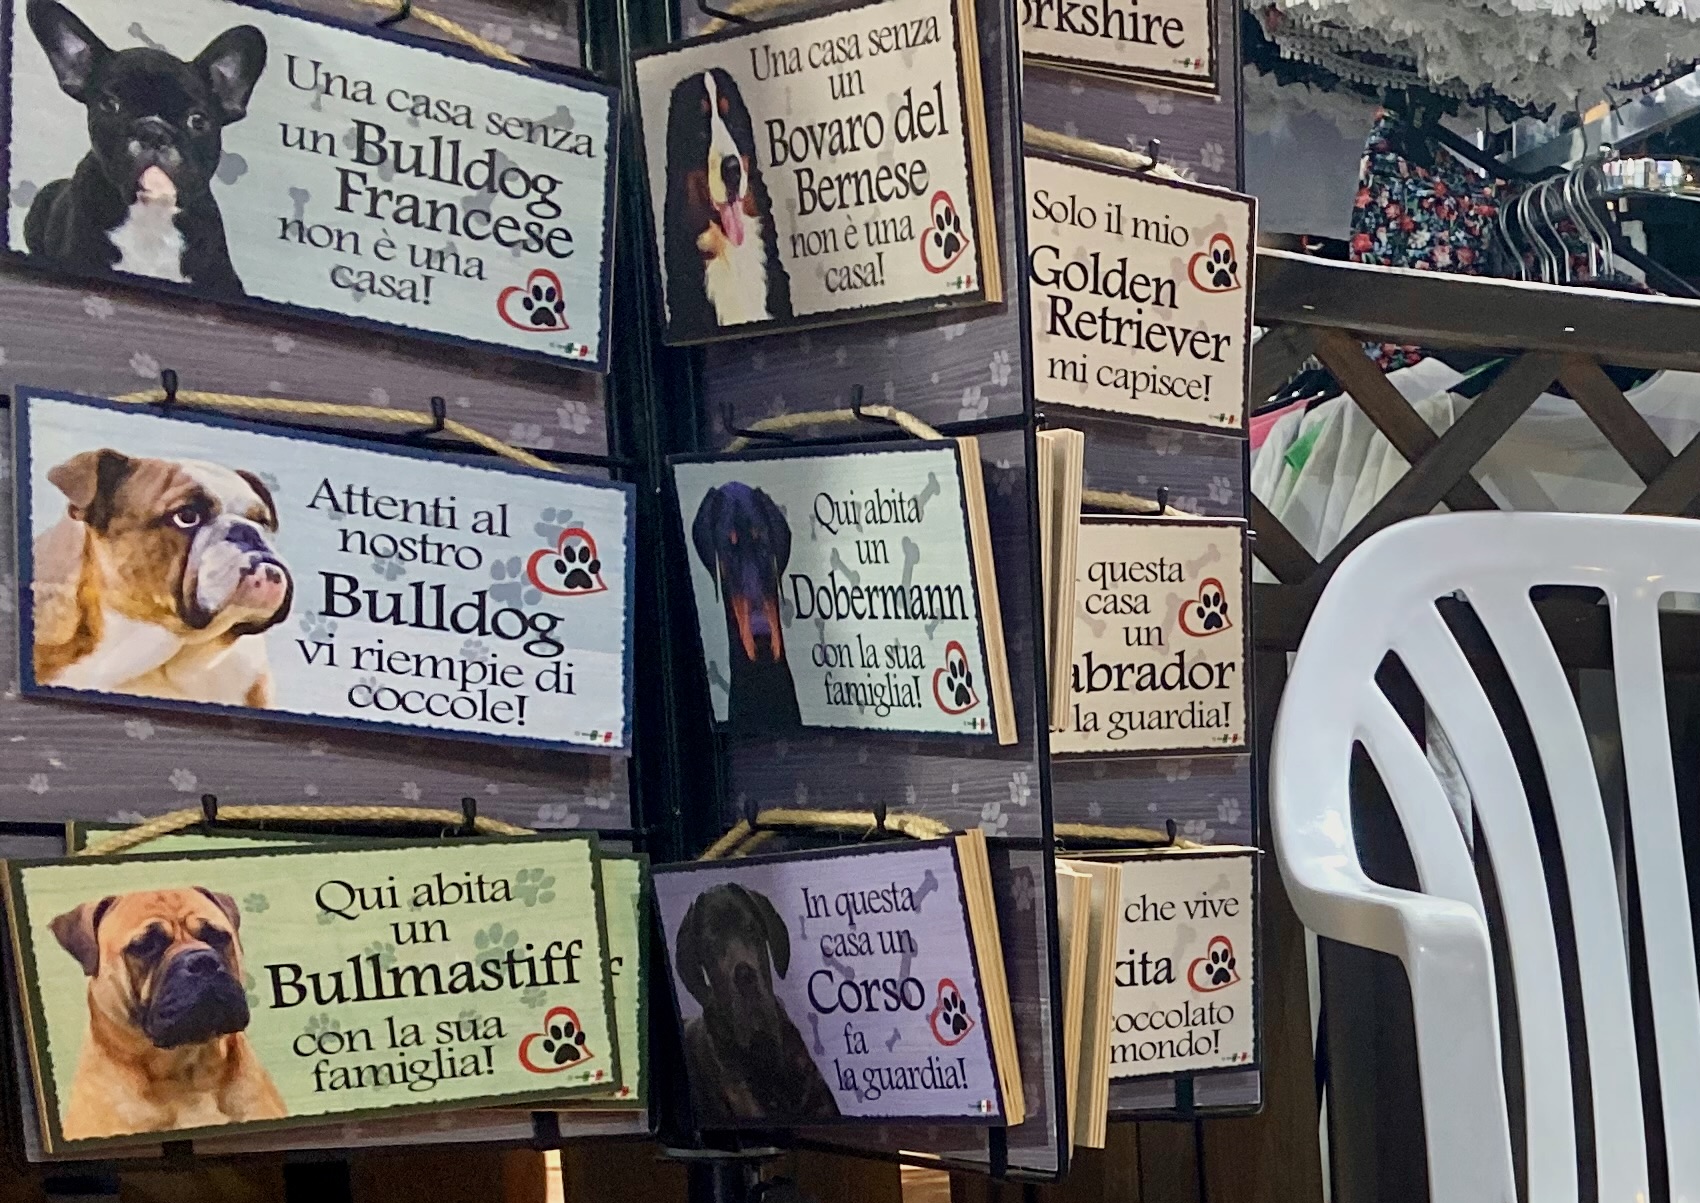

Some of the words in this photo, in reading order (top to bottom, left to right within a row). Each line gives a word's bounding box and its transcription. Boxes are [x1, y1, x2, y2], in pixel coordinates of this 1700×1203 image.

[749, 45, 802, 81] Una
[807, 32, 862, 70] casa
[868, 16, 941, 54] senza
[285, 54, 376, 105] Una
[387, 88, 473, 128] casa
[486, 110, 595, 158] senza
[828, 69, 864, 100] un
[765, 111, 884, 168] Bovaro
[894, 81, 949, 144] del
[279, 123, 336, 157] un
[350, 119, 563, 220] Bulldog
[793, 159, 929, 216] Bernese
[336, 168, 574, 259] Francese
[1032, 190, 1097, 229] Solo
[1104, 202, 1123, 235] il
[1131, 214, 1189, 247] mio
[277, 215, 361, 256] non
[373, 228, 396, 261] è
[408, 242, 487, 281] una
[791, 227, 839, 258] non
[844, 214, 858, 250] è
[864, 215, 915, 247] una
[331, 263, 431, 305] casa!
[824, 252, 886, 293] casa!
[1030, 245, 1178, 309] Golden
[1046, 294, 1231, 362] Retriever
[1048, 353, 1088, 384] mi
[1096, 364, 1213, 402] capisce!
[306, 478, 457, 529] Attenti
[471, 504, 509, 538] al
[813, 490, 860, 534] Qui
[865, 488, 924, 523] abita
[338, 529, 483, 571] nostro
[855, 539, 890, 564] un
[789, 571, 968, 619] Dobermann
[1087, 557, 1185, 590] questa
[318, 571, 565, 657] Bulldog
[1085, 592, 1151, 615] casa
[811, 639, 854, 668] con
[859, 634, 880, 669] la
[885, 643, 926, 669] sua
[1123, 625, 1164, 646] un
[296, 633, 337, 667] vi
[350, 639, 524, 692] riempie
[534, 661, 577, 695] di
[347, 683, 528, 726] coccole!
[824, 673, 922, 717] famiglia!
[1073, 703, 1100, 732] la
[1107, 701, 1231, 740] guardia!
[315, 878, 399, 919] Qui
[413, 871, 515, 907] abita
[801, 887, 831, 919] In
[835, 881, 917, 925] questa
[1124, 894, 1175, 922] che
[1183, 891, 1239, 919] vive
[390, 918, 449, 945] un
[820, 934, 874, 957] casa
[878, 928, 917, 953] un
[264, 940, 582, 1009] Bullmastiff
[807, 969, 926, 1015] Corso
[293, 1029, 375, 1057] con
[384, 1016, 424, 1049] la
[436, 1018, 506, 1044] sua
[843, 1021, 868, 1054] fa
[1111, 1000, 1234, 1034] occolato
[312, 1044, 494, 1092] famiglia!
[1110, 1029, 1220, 1064] mondo!
[834, 1058, 858, 1091] la
[862, 1056, 968, 1100] guardia!
